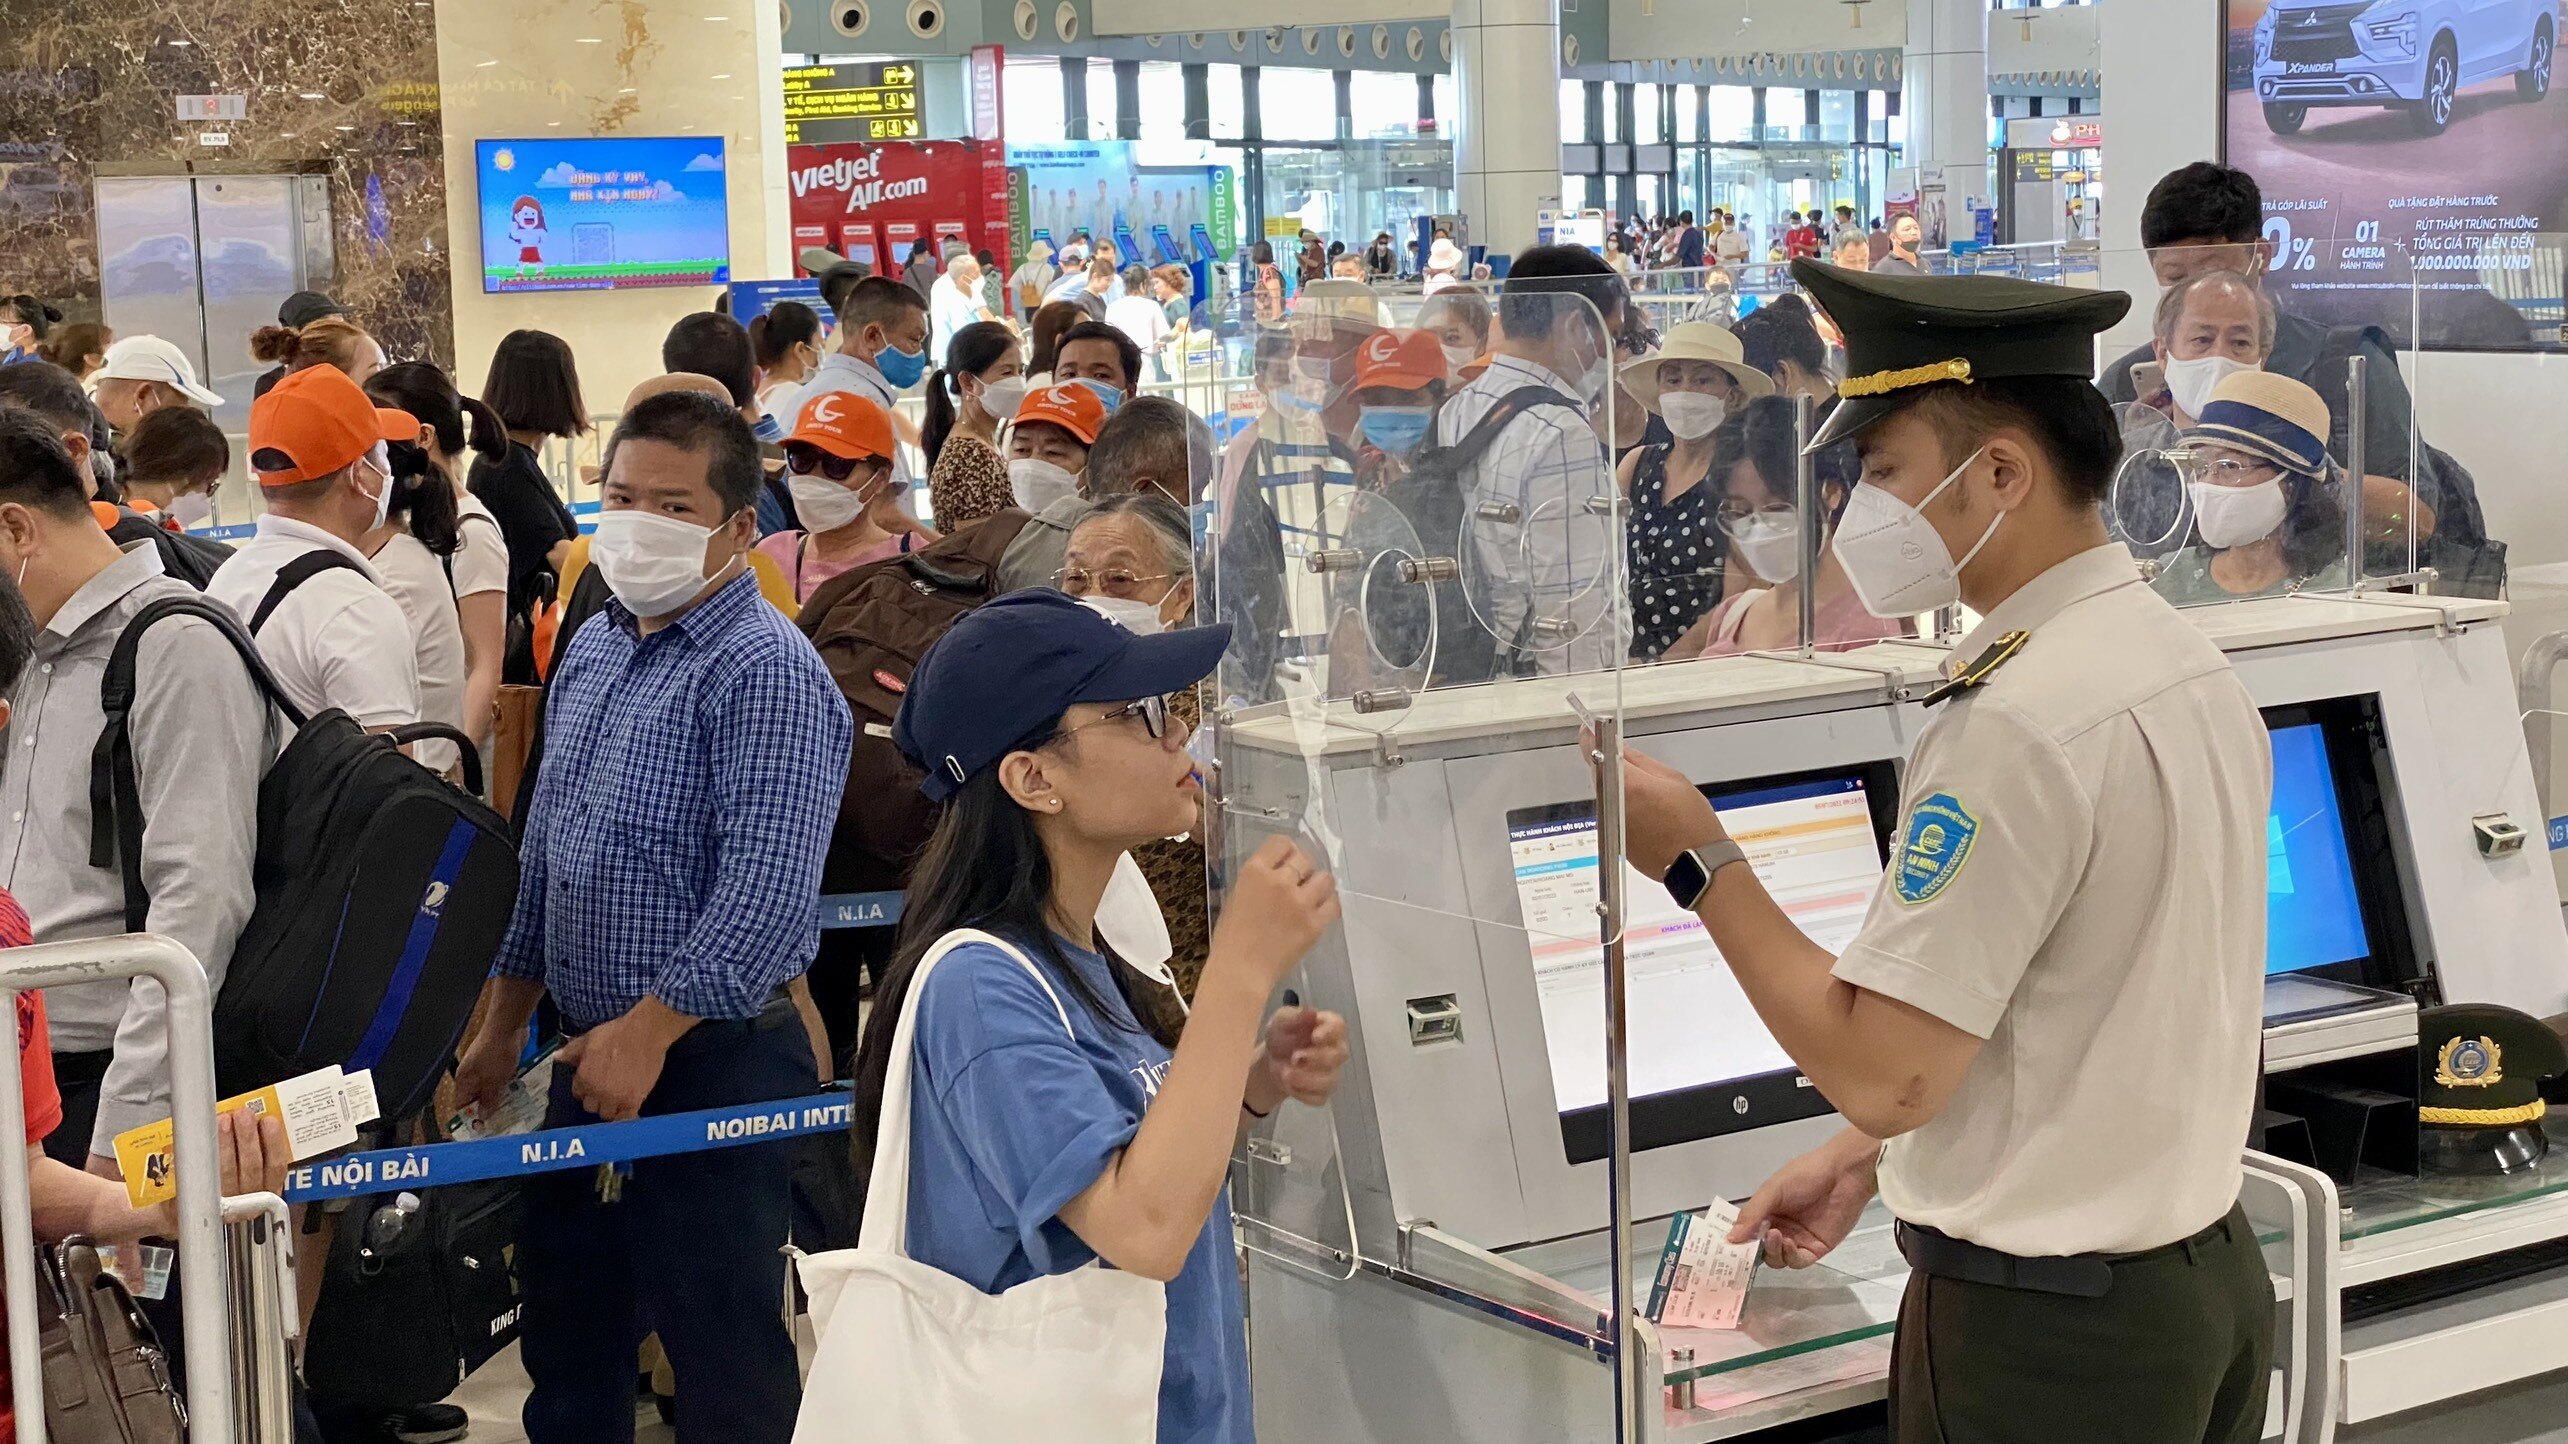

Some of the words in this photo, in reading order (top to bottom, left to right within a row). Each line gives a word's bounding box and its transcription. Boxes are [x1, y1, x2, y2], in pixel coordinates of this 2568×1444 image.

[2288, 62, 2334, 74] XPANDER
[2261, 199, 2277, 211] TRẢ
[2277, 200, 2293, 211] GÓP
[2294, 199, 2307, 210] LÃI
[2308, 197, 2328, 209] SUẤT
[2388, 199, 2405, 209] QUÀ
[2407, 196, 2428, 209] TẶNG
[2428, 196, 2445, 209] ĐẶT
[2445, 195, 2469, 206] HÀNG
[2470, 194, 2499, 206] TRƯỚC
[1007, 171, 1021, 259] BAMBOO
[1213, 169, 1227, 250] BAMBOO
[2415, 216, 2434, 230] RÚT
[2436, 216, 2463, 229] THĂM
[2464, 215, 2496, 229] TRÚNG
[1560, 227, 1576, 236] NIA
[2355, 220, 2379, 243] 01
[2413, 231, 2441, 250] TỔNG
[2443, 233, 2462, 249] GIÁ
[2465, 237, 2482, 251] TRỊ
[2485, 232, 2507, 249] LÊN
[2510, 230, 2535, 249] ĐẾN
[2342, 246, 2386, 258] CAMERA
[2340, 260, 2361, 270] HÀNH
[2362, 259, 2384, 270] TRÌNH
[2502, 254, 2532, 269] VND
[824, 424, 842, 434] TOUR
[1543, 825, 1562, 834] KHÁCH
[838, 904, 884, 921] N.I.A
[706, 1111, 796, 1141] NOIBAI
[521, 1138, 586, 1164] N.I.A
[322, 1158, 373, 1190] NỘI
[381, 1152, 430, 1181] BÀI
[490, 1308, 515, 1337] KING
